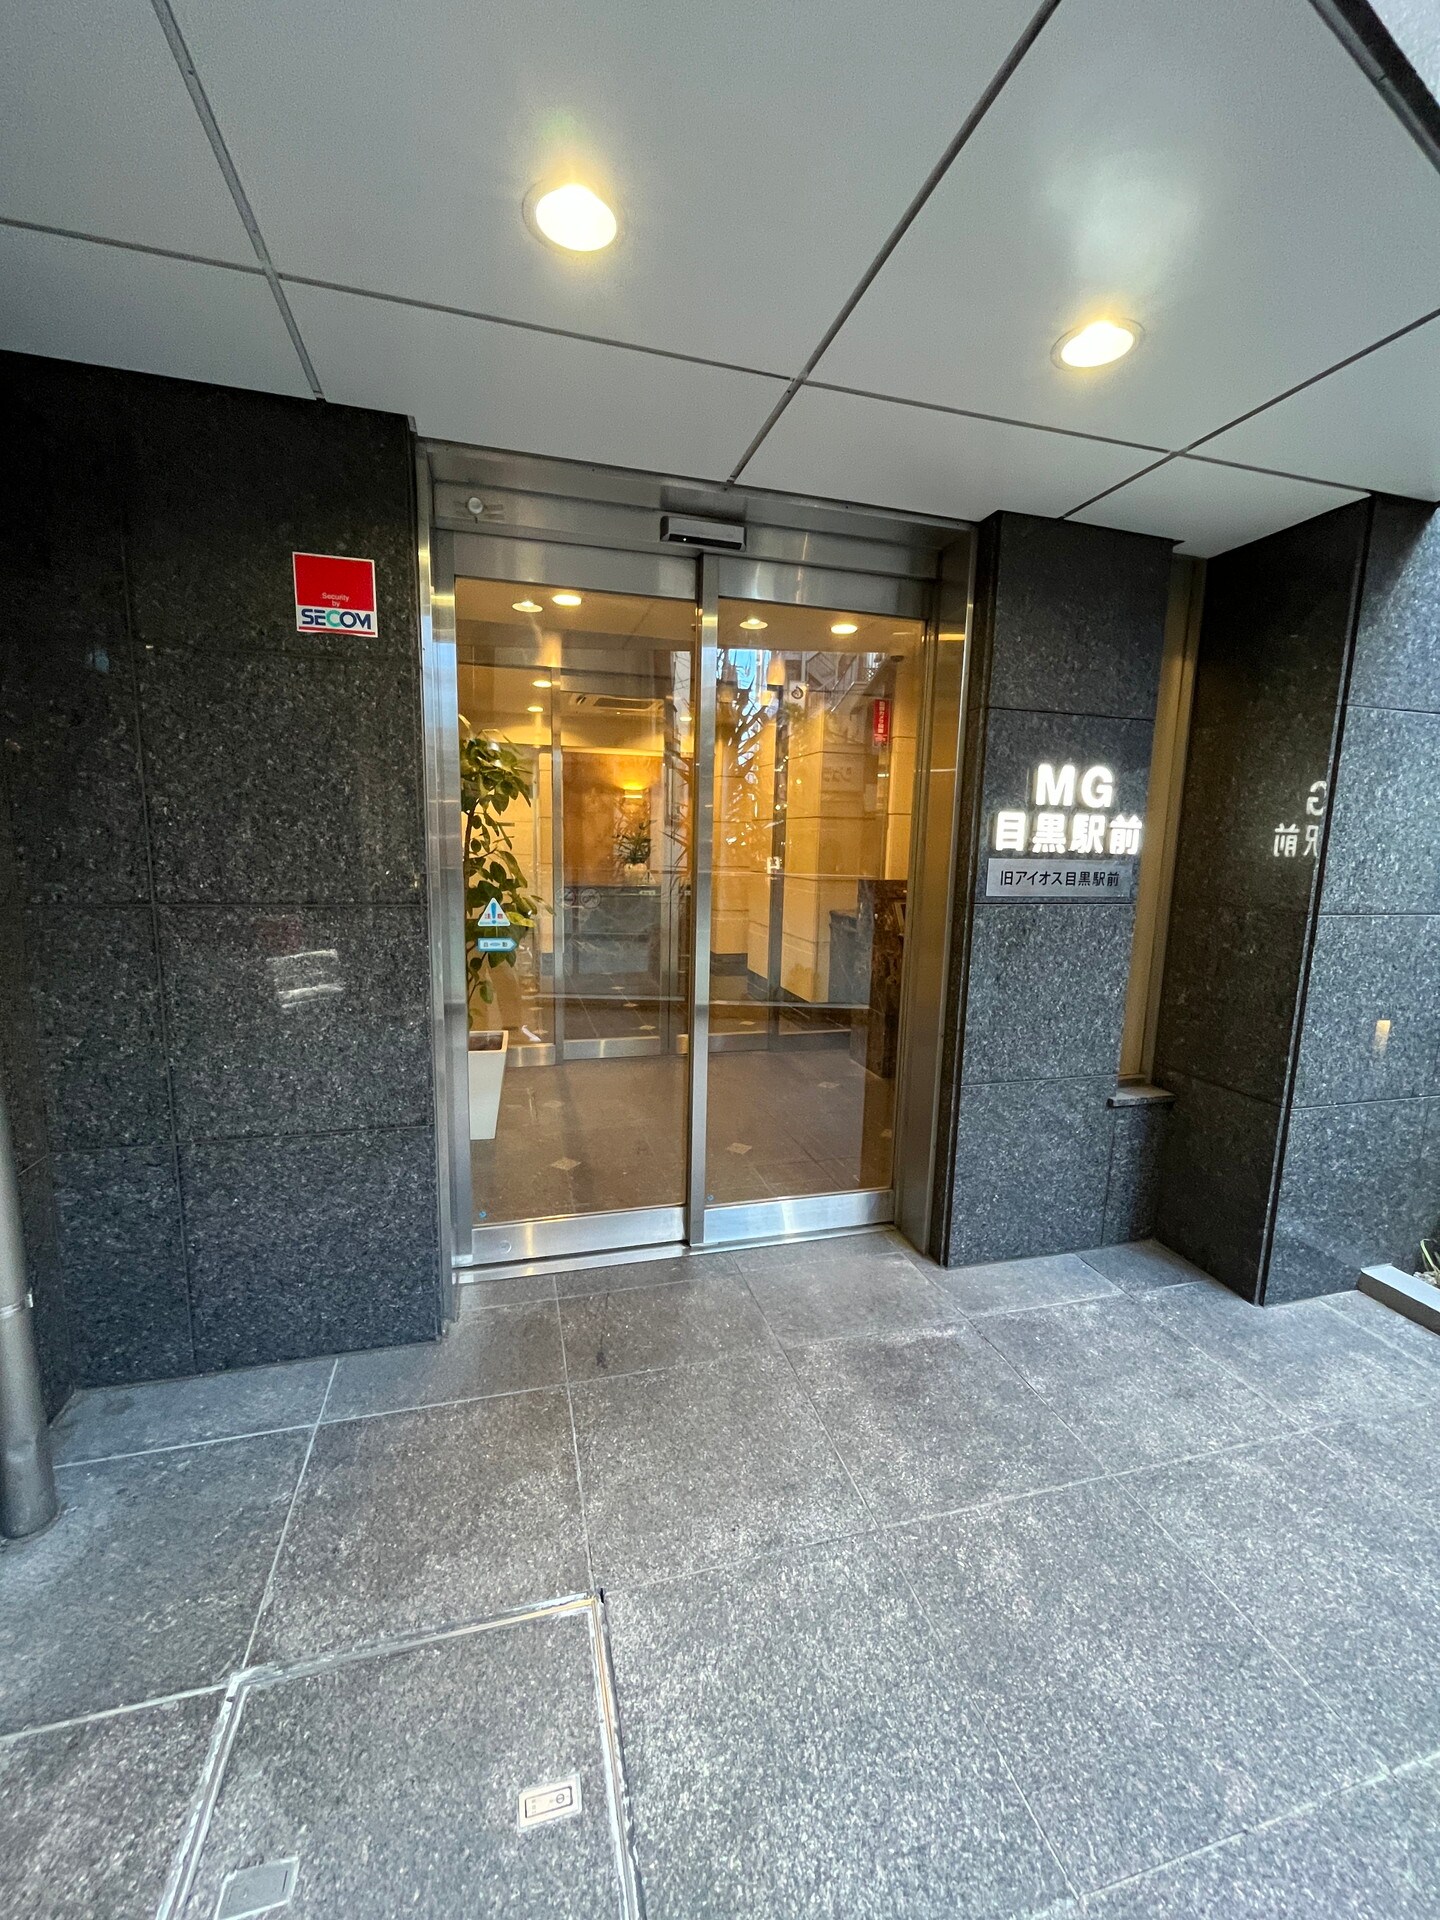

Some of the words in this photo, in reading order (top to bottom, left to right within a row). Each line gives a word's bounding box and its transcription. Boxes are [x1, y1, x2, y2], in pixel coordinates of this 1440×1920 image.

[321, 592, 350, 602] Security
[331, 600, 341, 608] by
[301, 608, 372, 630] SECOM
[1034, 763, 1114, 808] MG
[995, 810, 1143, 855] 目黒駅前
[1000, 870, 1120, 887] 旧アイオス目黒駅前
